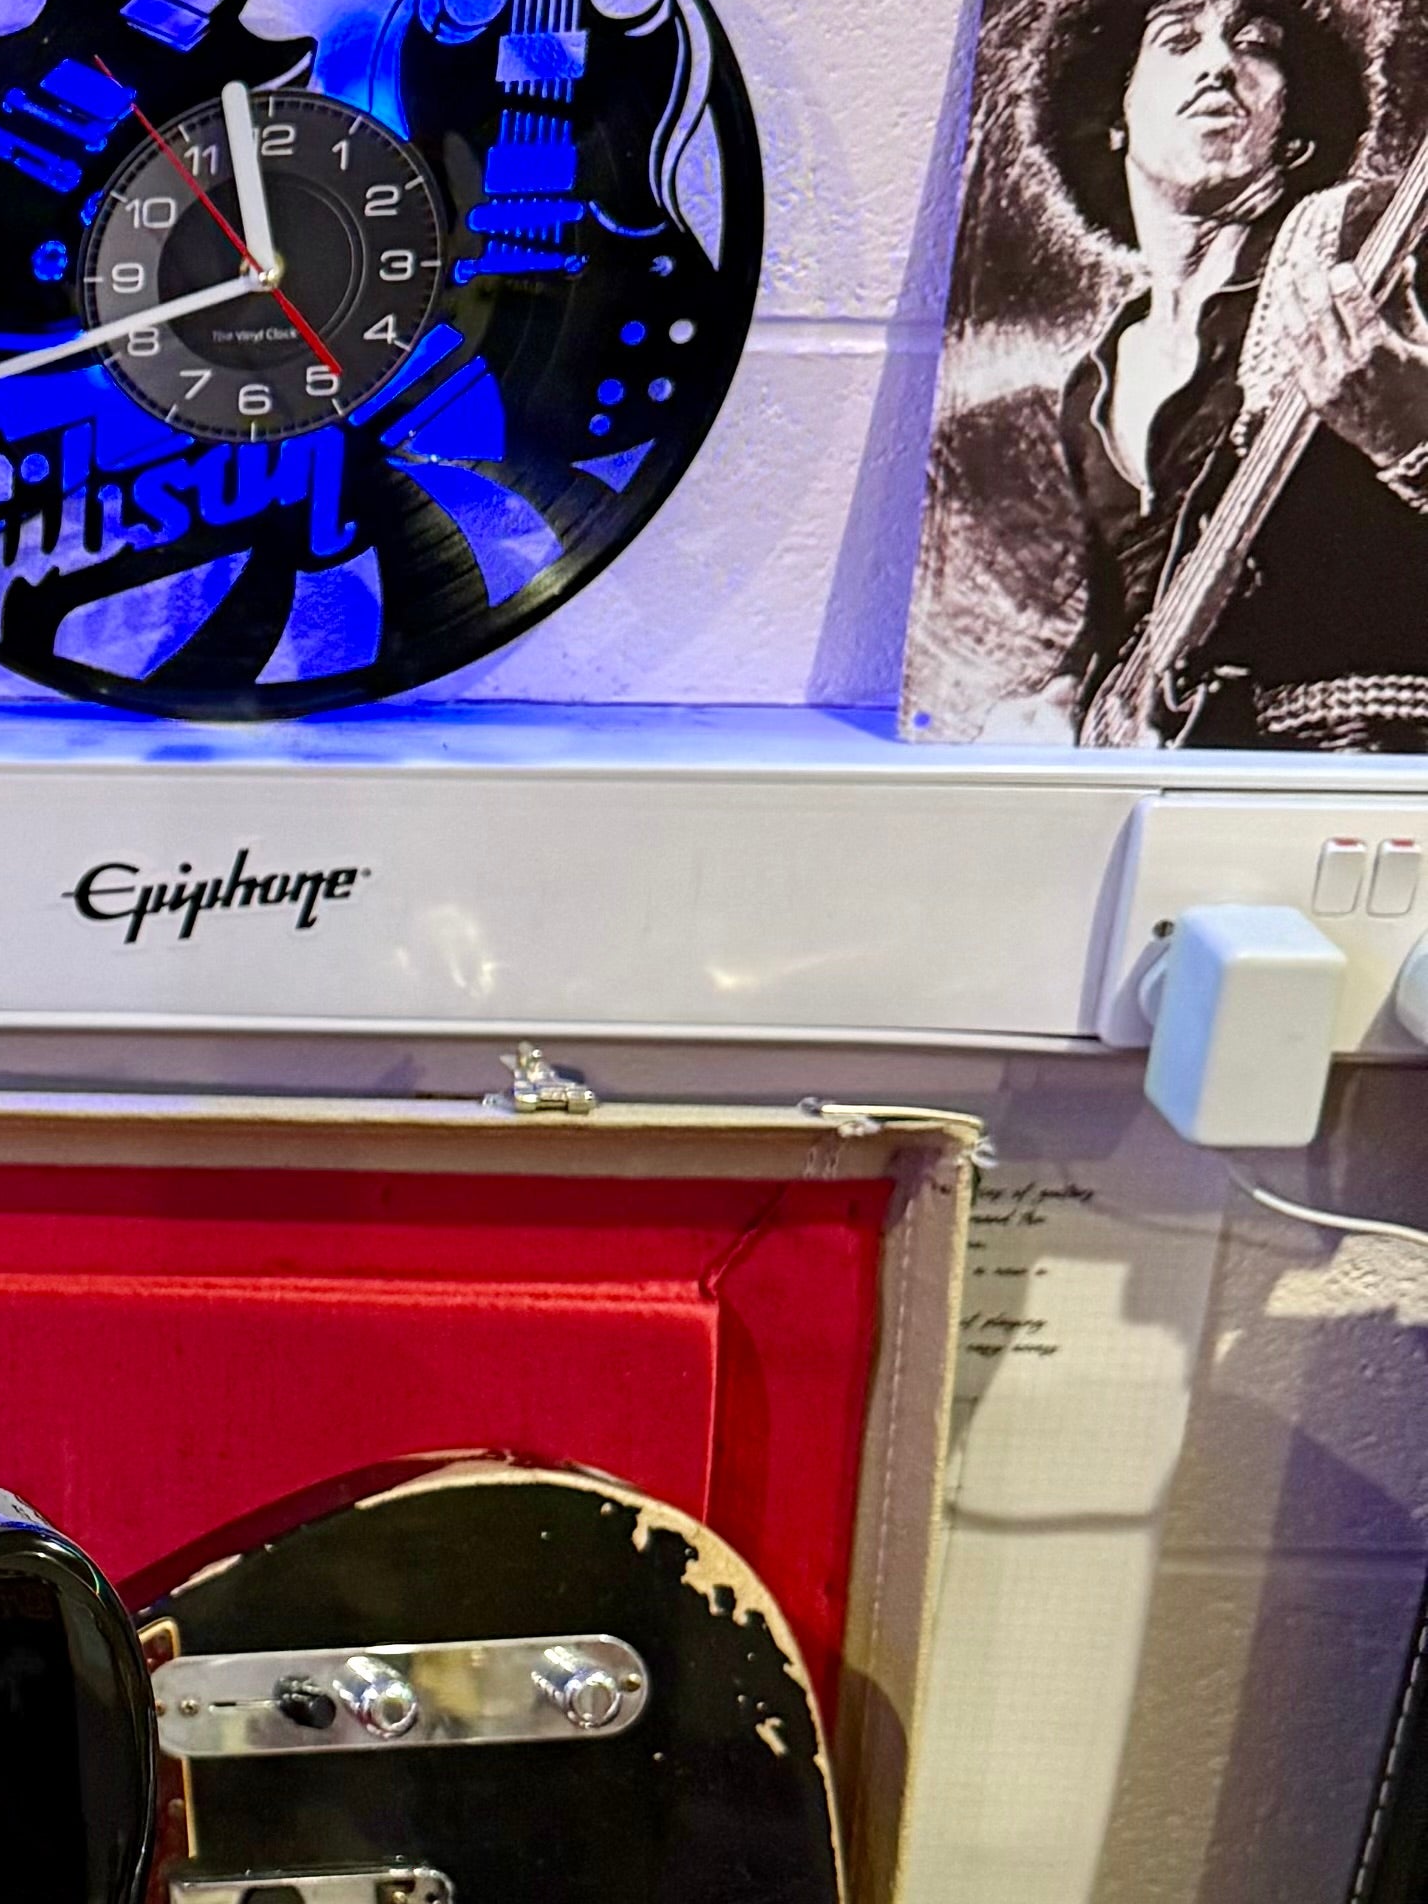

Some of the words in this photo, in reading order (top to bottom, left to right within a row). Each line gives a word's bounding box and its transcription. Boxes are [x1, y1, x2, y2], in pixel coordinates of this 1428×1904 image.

[252, 123, 296, 157] 2
[332, 139, 351, 171] 1
[183, 143, 220, 177] 11
[124, 196, 177, 230] 10
[364, 184, 399, 217] 2
[111, 262, 146, 294] 9
[379, 249, 414, 283] 3
[126, 327, 160, 357] 8
[363, 313, 396, 345] 4
[179, 368, 212, 400] 7
[305, 364, 342, 396] 5
[238, 383, 273, 416] 6
[61, 848, 359, 944] Epiphone
